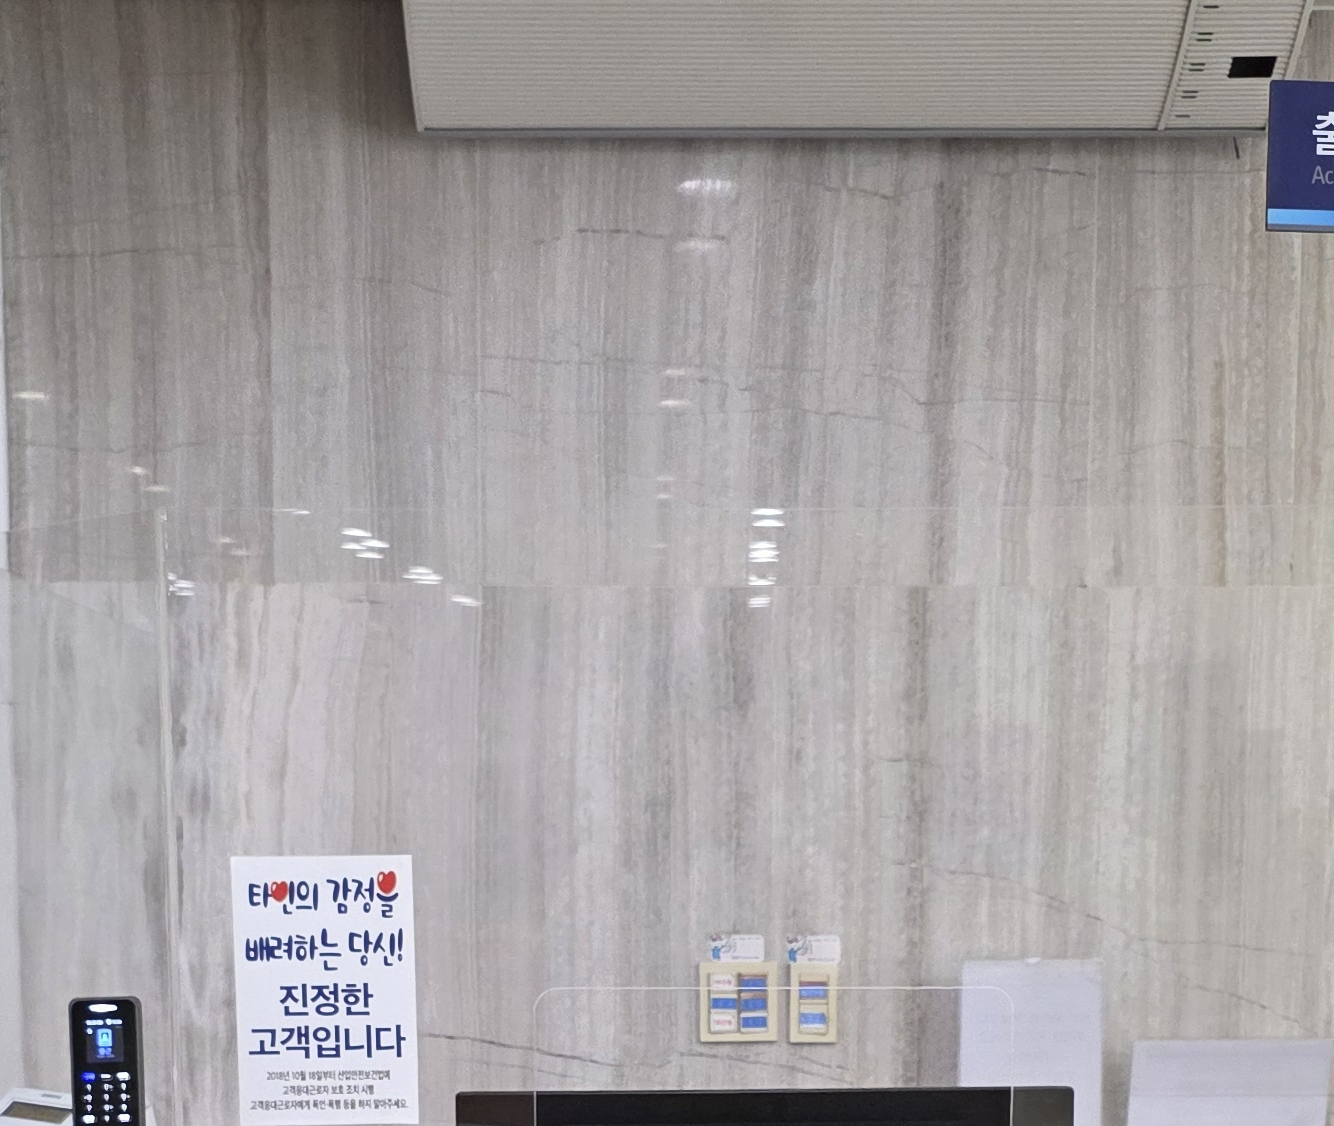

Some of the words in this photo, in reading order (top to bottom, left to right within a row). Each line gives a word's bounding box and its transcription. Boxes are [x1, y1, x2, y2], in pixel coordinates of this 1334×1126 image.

[248, 881, 319, 915] 타인의
[326, 870, 399, 918] 감정을
[245, 928, 343, 972] 배려하는
[347, 928, 404, 967] 당신!
[279, 983, 374, 1016] 진정한
[248, 1024, 407, 1059] 고객입니다
[266, 1071, 291, 1081] 2018년
[291, 1070, 307, 1081] 10월
[308, 1070, 336, 1081] 18일부터
[282, 1085, 329, 1096] 고객응대근로자
[331, 1085, 344, 1095] 보호
[346, 1085, 360, 1095] 조치
[250, 1100, 311, 1111] 고객응대근로자에게
[343, 1099, 357, 1110] 등을
